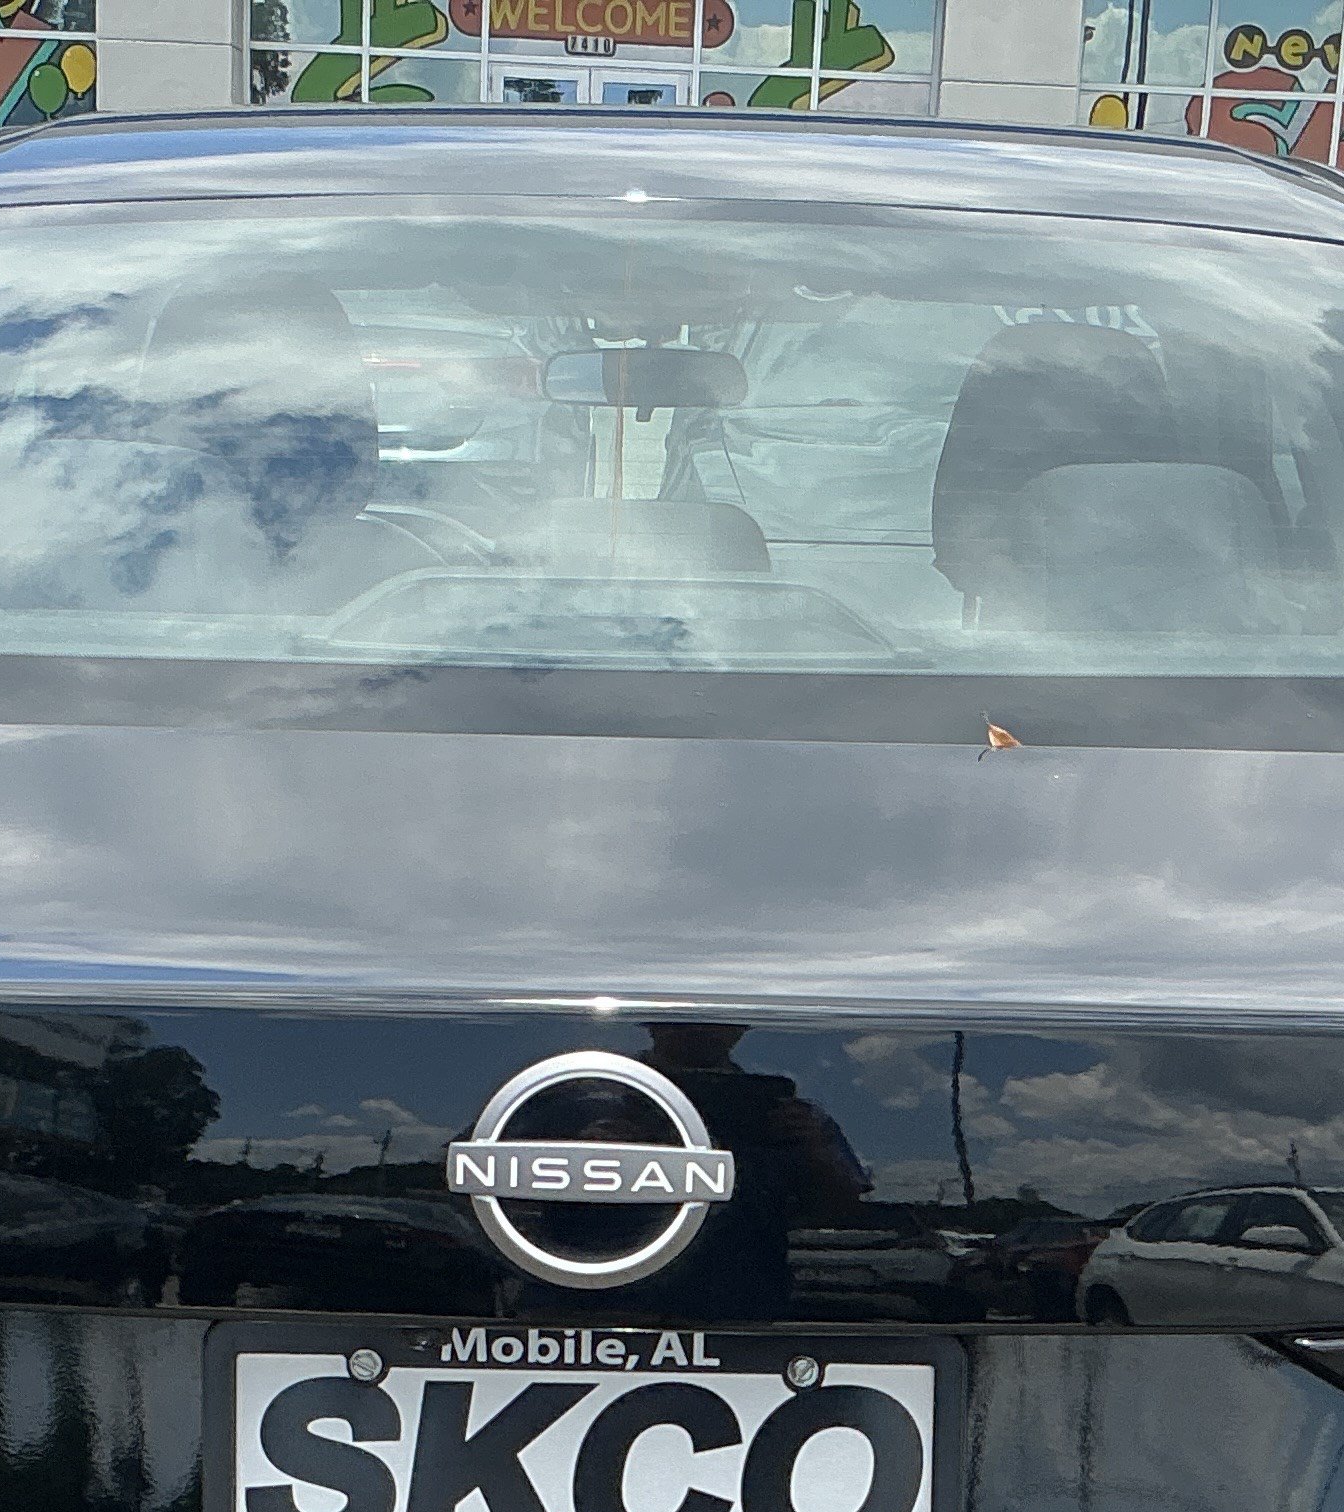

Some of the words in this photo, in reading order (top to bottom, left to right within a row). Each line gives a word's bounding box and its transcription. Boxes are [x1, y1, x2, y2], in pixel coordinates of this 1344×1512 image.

[490, 0, 692, 38] WELCOME
[570, 36, 611, 52] 7410
[455, 1152, 725, 1193] NISSAN
[440, 1327, 639, 1370] Mobile,
[650, 1332, 721, 1367] AL
